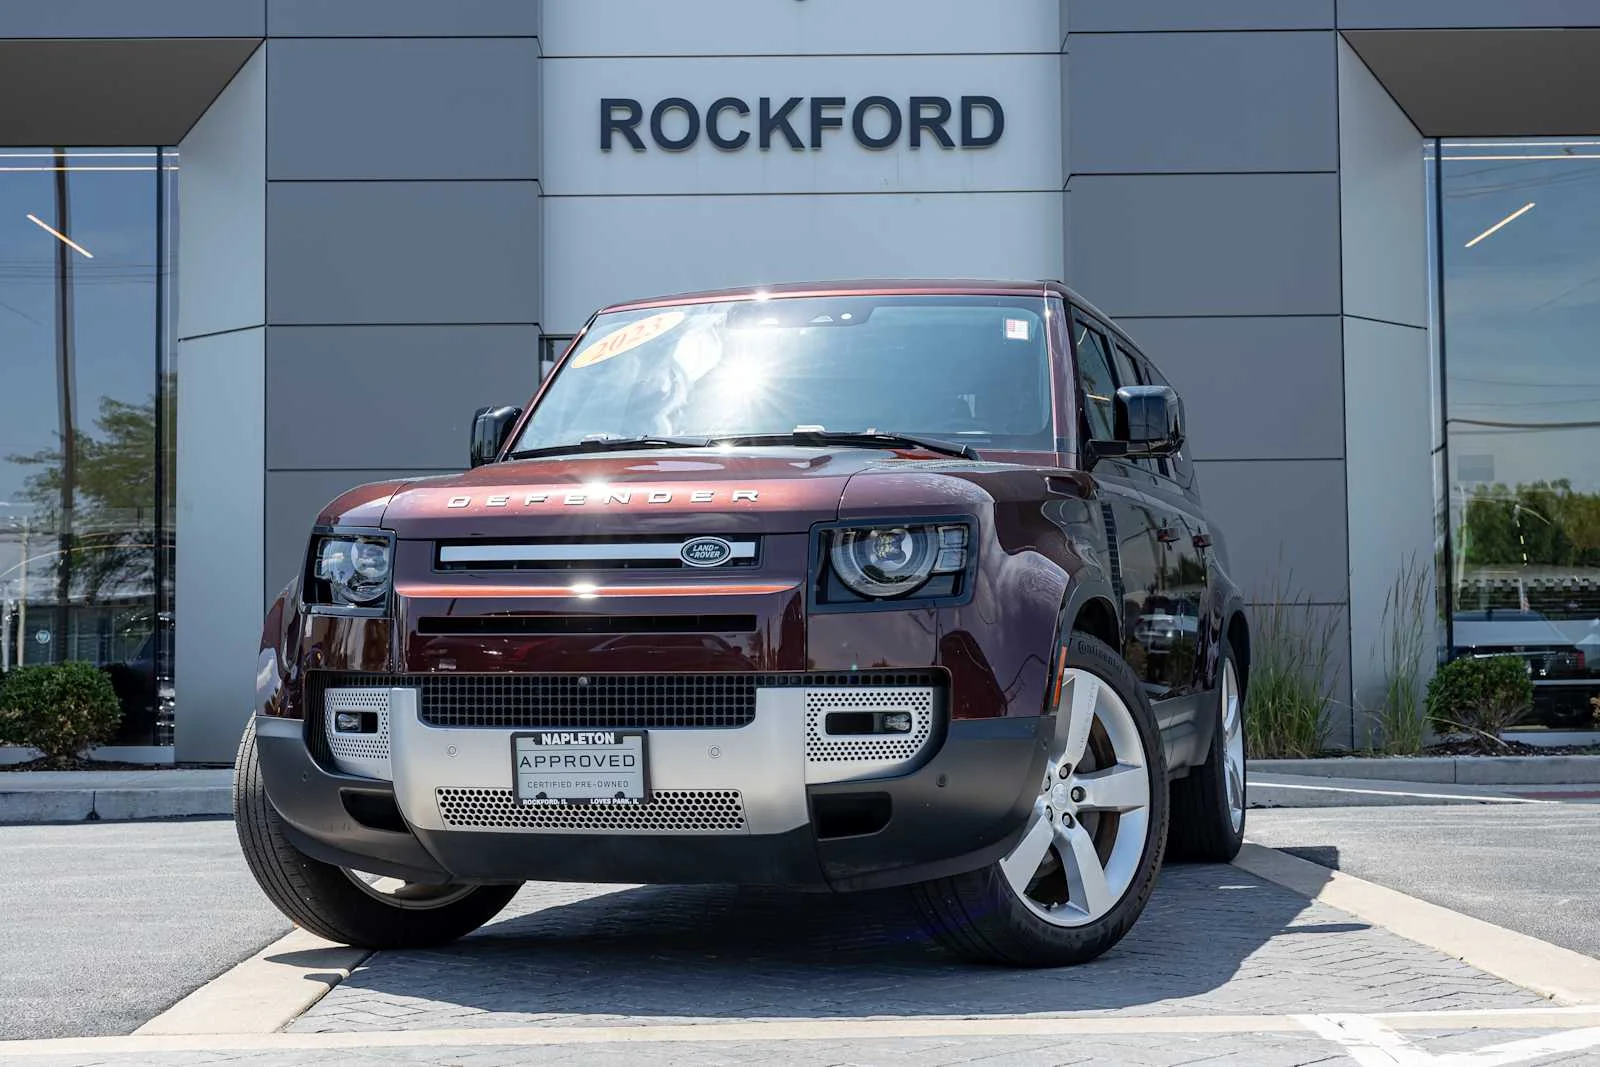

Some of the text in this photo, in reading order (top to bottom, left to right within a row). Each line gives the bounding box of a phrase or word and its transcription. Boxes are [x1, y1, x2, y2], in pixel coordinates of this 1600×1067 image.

[600, 95, 1005, 152] ROCKFORD
[447, 489, 759, 509] DEFENDER
[541, 732, 615, 745] NAPLETON
[519, 754, 635, 768] APPROVED
[527, 780, 629, 789] CERTIFIED PRE-OWNED
